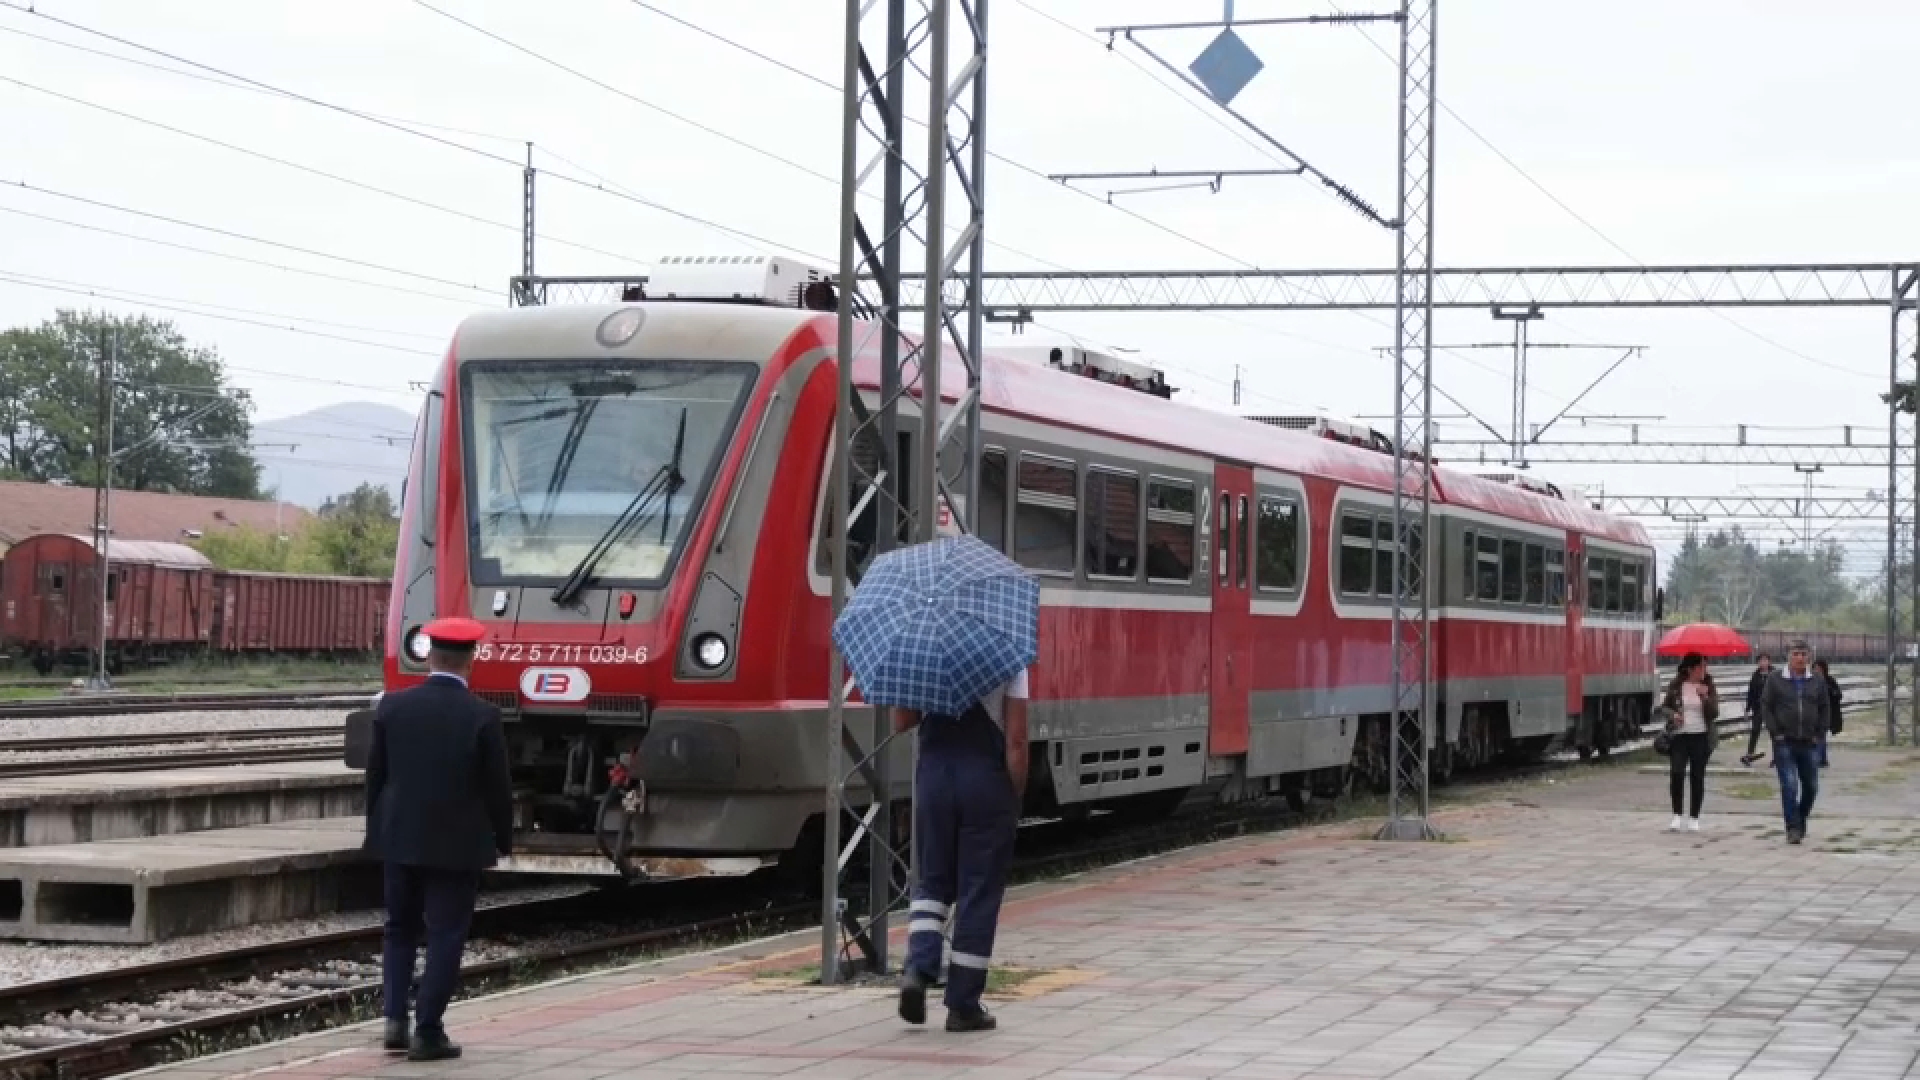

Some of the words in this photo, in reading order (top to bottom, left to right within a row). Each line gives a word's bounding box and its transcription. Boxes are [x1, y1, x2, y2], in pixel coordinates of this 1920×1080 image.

[499, 644, 524, 662] 72
[529, 644, 542, 662] 5
[550, 645, 583, 662] 711
[589, 646, 648, 664] 039-6
